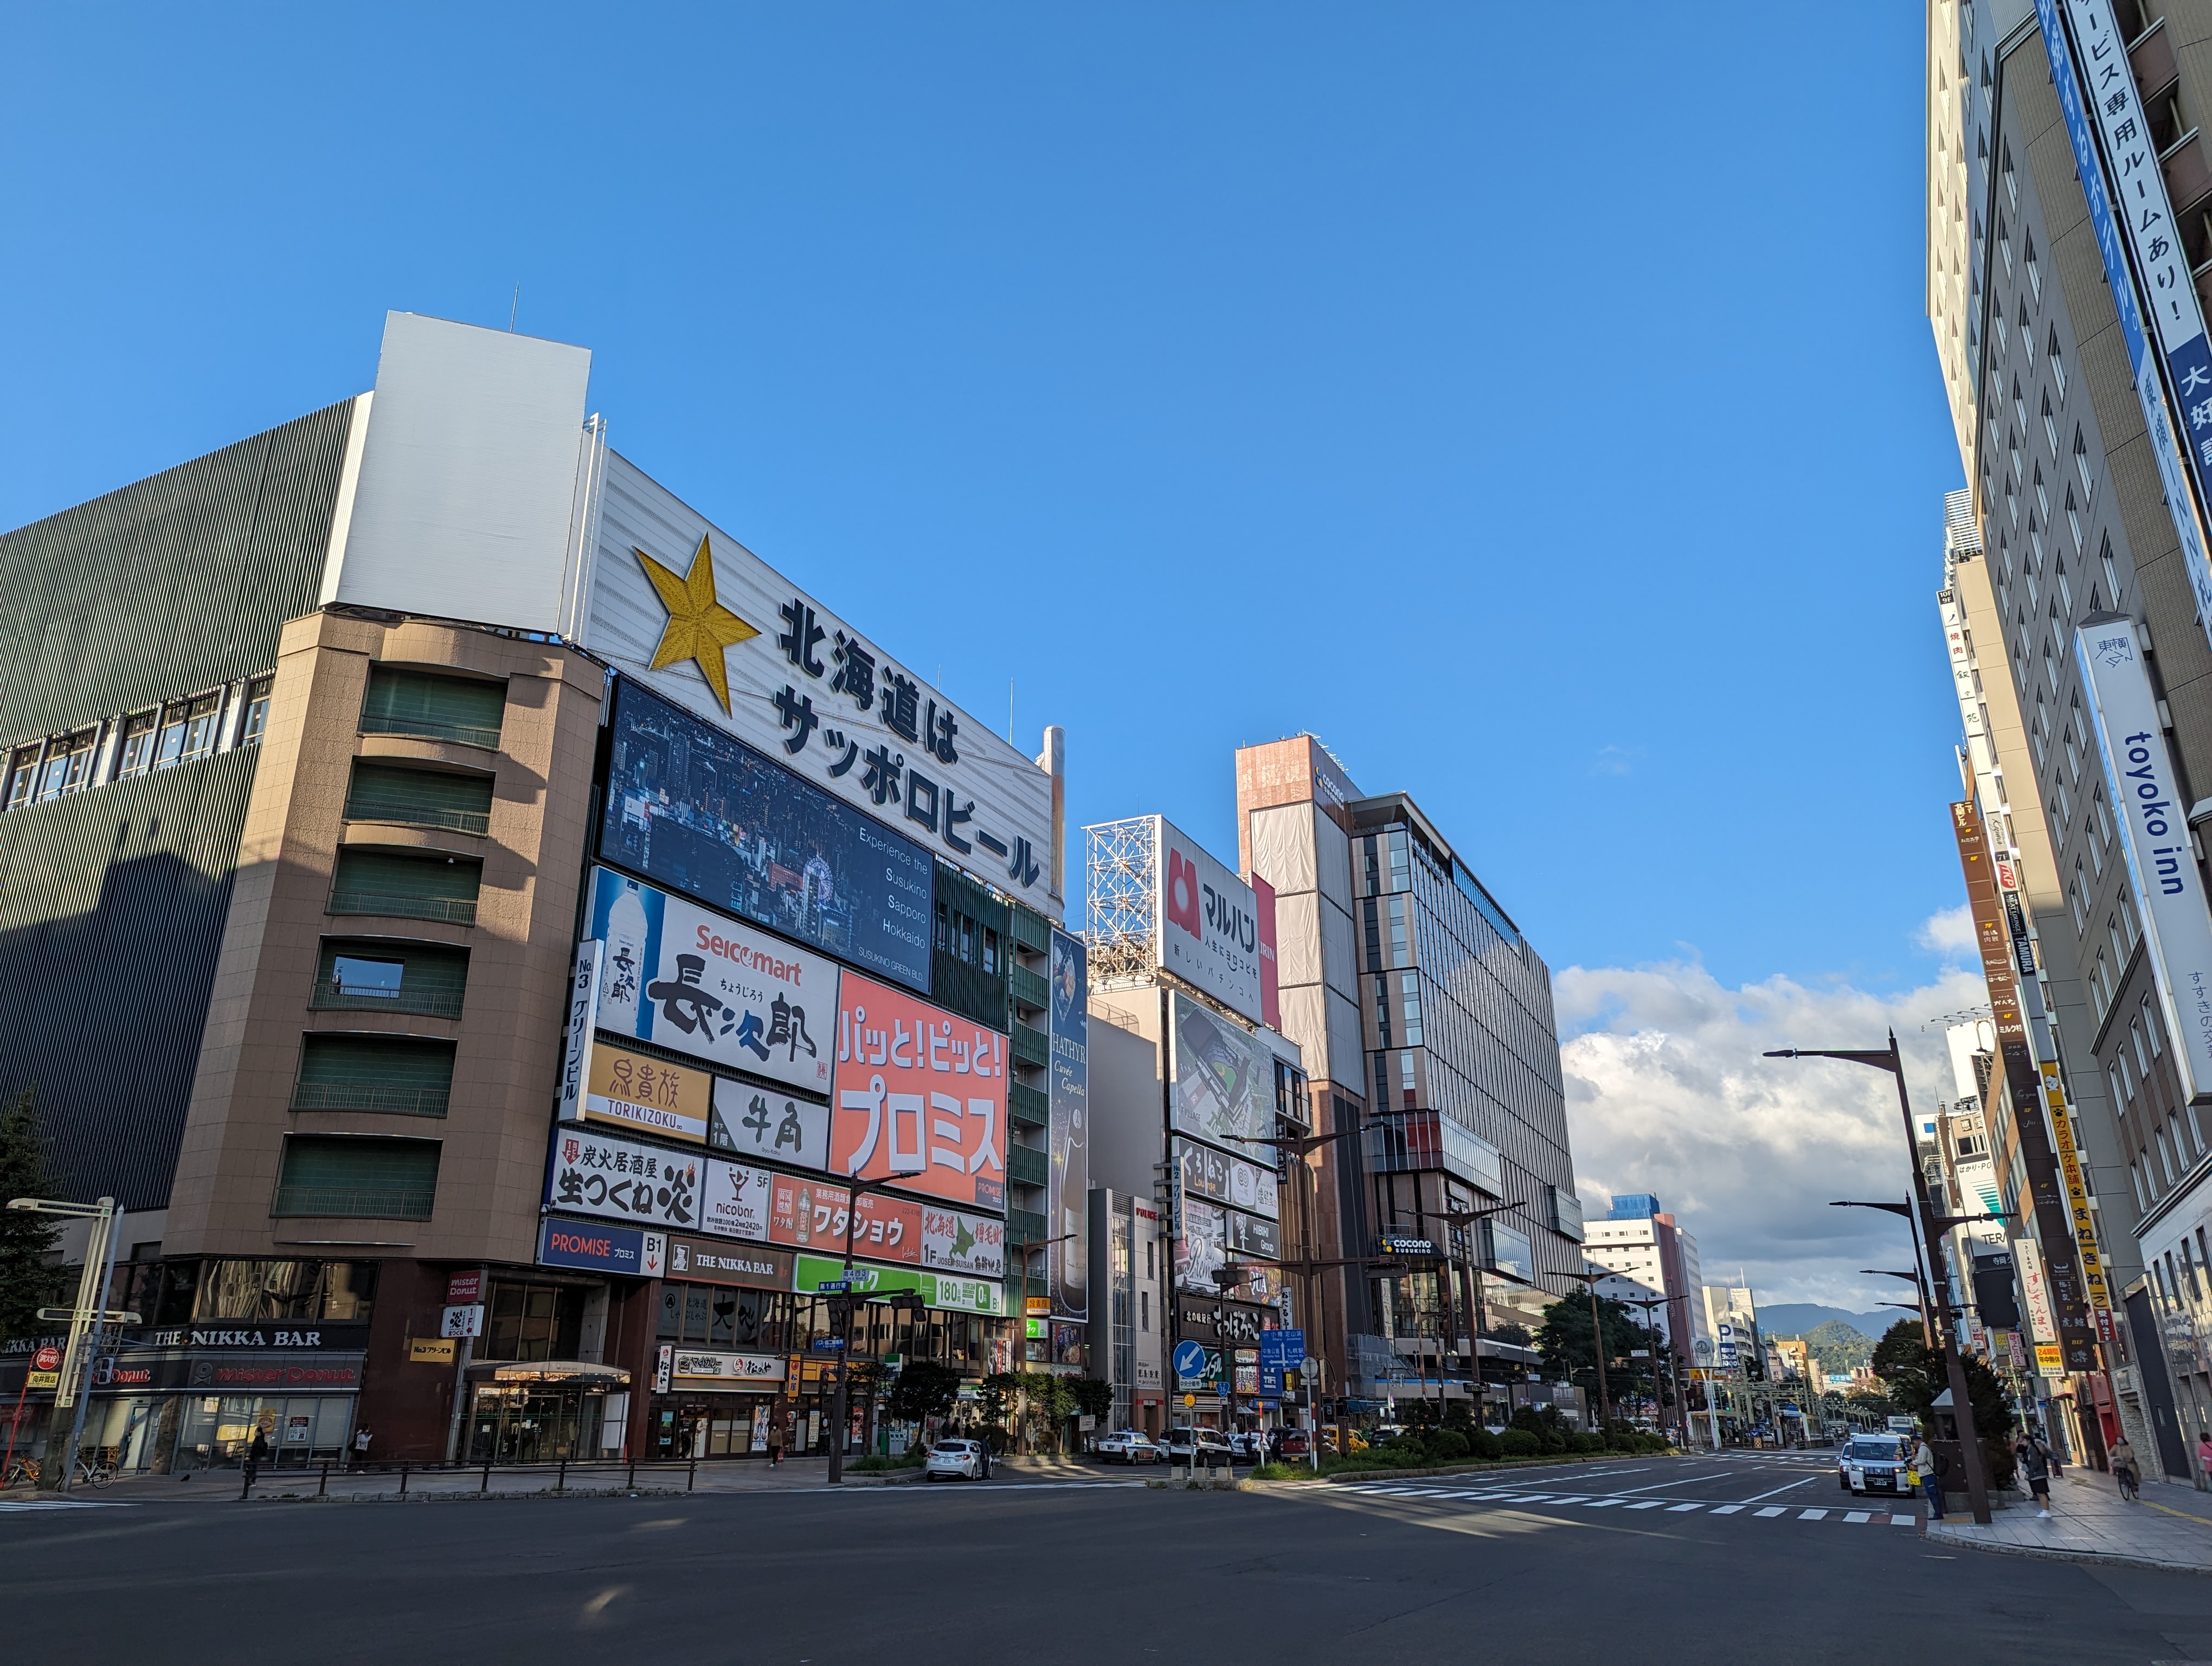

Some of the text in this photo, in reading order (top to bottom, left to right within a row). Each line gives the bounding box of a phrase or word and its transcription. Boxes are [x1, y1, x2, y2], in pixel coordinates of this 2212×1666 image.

[2075, 0, 2180, 320] ービス専用ルームあり!
[1950, 632, 1963, 654] 焼肉
[779, 597, 959, 764] 北海道は
[774, 684, 1039, 888] サッポロビール
[2125, 731, 2184, 895] toyoko inn
[860, 827, 928, 875] Experience the
[886, 868, 927, 899] Susukino
[2003, 866, 2015, 888] TKP
[889, 895, 926, 924] Sapporo
[1203, 883, 1255, 953] マルハン
[883, 918, 925, 949] Hokkaido
[696, 924, 802, 986] Seicomart
[859, 947, 923, 982] SUSUKINO GREEN BLD.
[1205, 936, 1257, 979] 人生にヨロコビを
[2017, 935, 2034, 973] TAMURA
[612, 947, 635, 1003] 長次郎
[1174, 943, 1254, 1003] 新しいパチンコへ
[719, 978, 763, 1003] ちょうじろう
[648, 953, 816, 1062] 長次郎
[563, 1001, 588, 1100] グリーンビル
[840, 1005, 1001, 1077] パッと!ピッと!
[1052, 1031, 1086, 1064] HATHYR
[1054, 1060, 1073, 1078] Cuvée
[609, 1058, 680, 1109] 鳥貴族
[1062, 1077, 1085, 1097] Capella
[608, 1099, 677, 1129] TORIKIZOKU
[713, 1121, 724, 1130] 地下
[742, 1094, 801, 1154] 牛角
[841, 1074, 1003, 1175] プロミス
[1185, 1109, 1201, 1122] VILLAGE
[566, 1141, 571, 1160] 1F
[713, 1131, 729, 1146] 1階
[580, 1144, 657, 1179] 炭火居酒屋
[1184, 1146, 1223, 1182] くろねこ
[2056, 1119, 2080, 1185] カラオケ本舗
[757, 1176, 768, 1188] 5F
[978, 1182, 1001, 1197] PROMISE
[1194, 1175, 1216, 1192] Lounge
[716, 1202, 754, 1219] nicobar
[815, 1188, 874, 1209] 業務用酒類食卸販売
[814, 1204, 903, 1246] ワタショウ
[924, 1211, 955, 1239] 北海道
[1136, 1207, 1158, 1220] POLICE
[975, 1222, 1002, 1247] 増毛町
[1253, 1223, 1269, 1238] HIBIKI
[551, 1234, 611, 1257] PROMISE
[614, 1248, 635, 1260] プロミス
[646, 1237, 661, 1253] B1
[924, 1244, 936, 1263] 1F
[1261, 1239, 1274, 1253] Group
[697, 1254, 774, 1275] THE NIKKA BAR
[937, 1258, 973, 1270] UOSEN-SUISAN
[2074, 1208, 2107, 1308] まねきねこ
[449, 1287, 478, 1296] Donut
[940, 1280, 957, 1302] 180
[2027, 1272, 2048, 1333] すしざんまい
[993, 1298, 999, 1310] B1
[1187, 1311, 1211, 1324] 北の味紀行
[156, 1331, 321, 1346] THE NIKKA BAR
[1718, 1324, 1731, 1342] P
[38, 1354, 57, 1363] 消火栓
[747, 1360, 771, 1374] 松のや
[112, 1369, 151, 1383] Donut
[287, 1367, 355, 1382] Donut
[660, 1361, 669, 1385] 松のや
